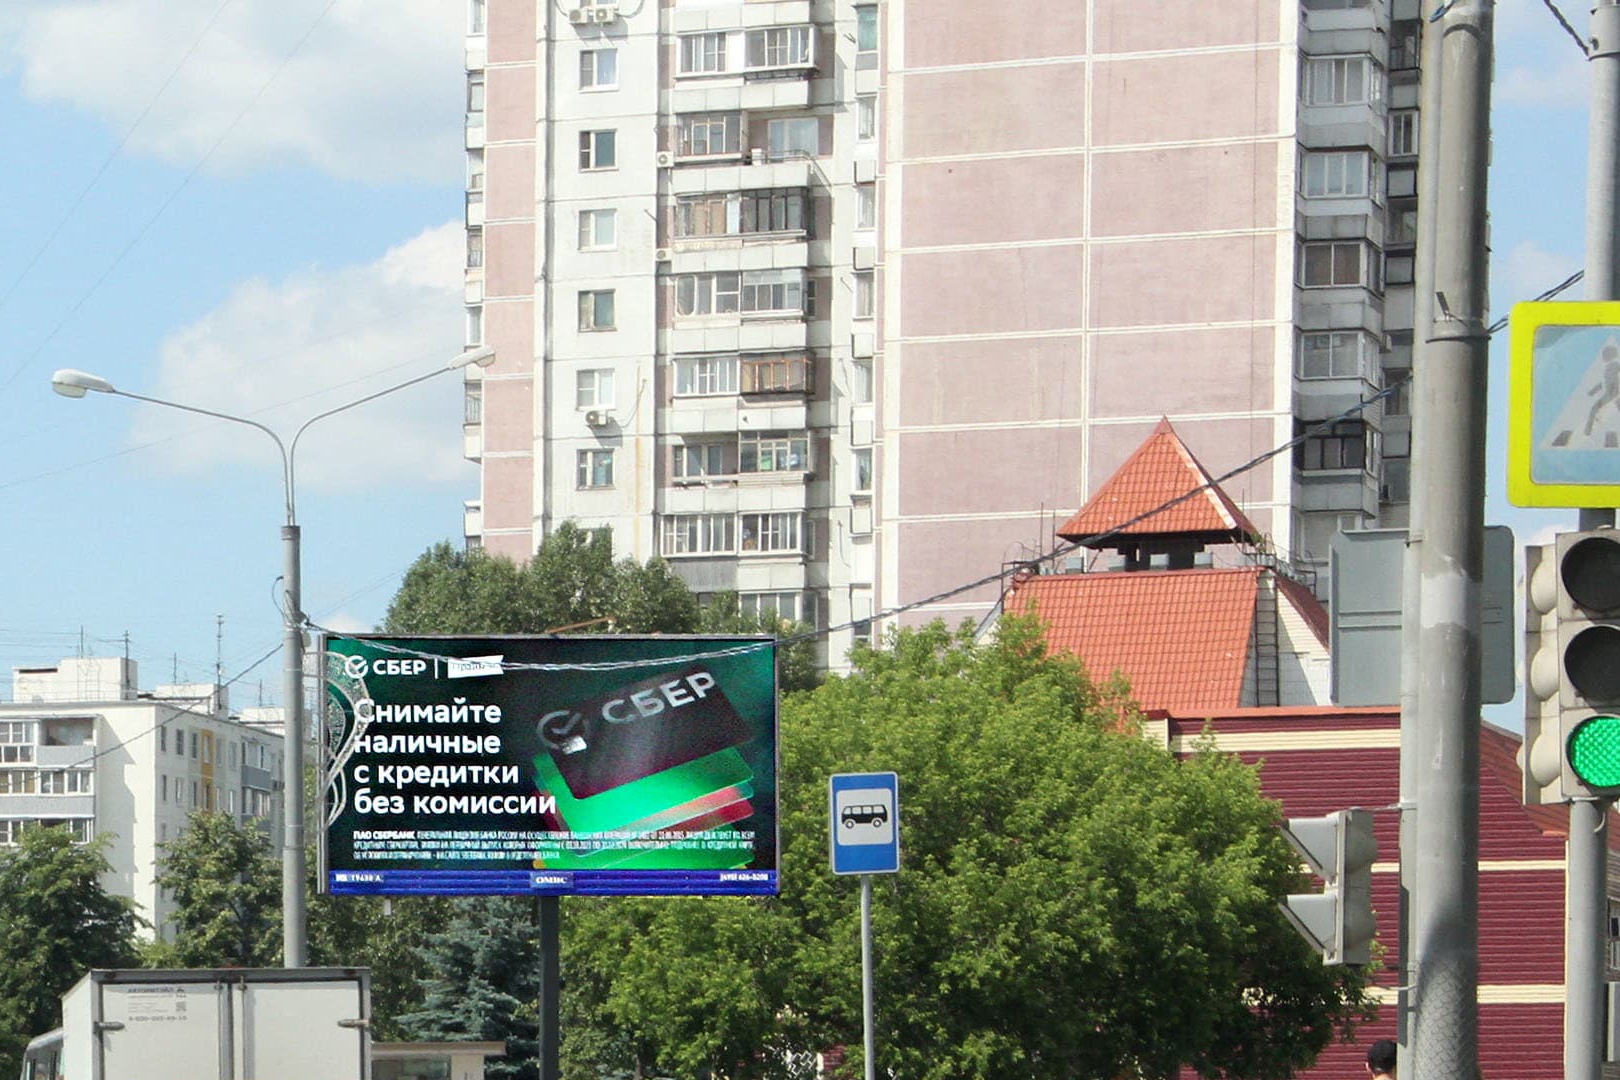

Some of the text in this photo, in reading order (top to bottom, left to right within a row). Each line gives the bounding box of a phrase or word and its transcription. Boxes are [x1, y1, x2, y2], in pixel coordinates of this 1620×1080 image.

[372, 659, 427, 675] СБЕР
[601, 671, 716, 724] СБЕР
[354, 697, 502, 724] Снимайте
[354, 734, 501, 754] наличные
[353, 764, 519, 789] с кредитки
[354, 788, 556, 814] без комиссии
[353, 830, 372, 840] ПАО
